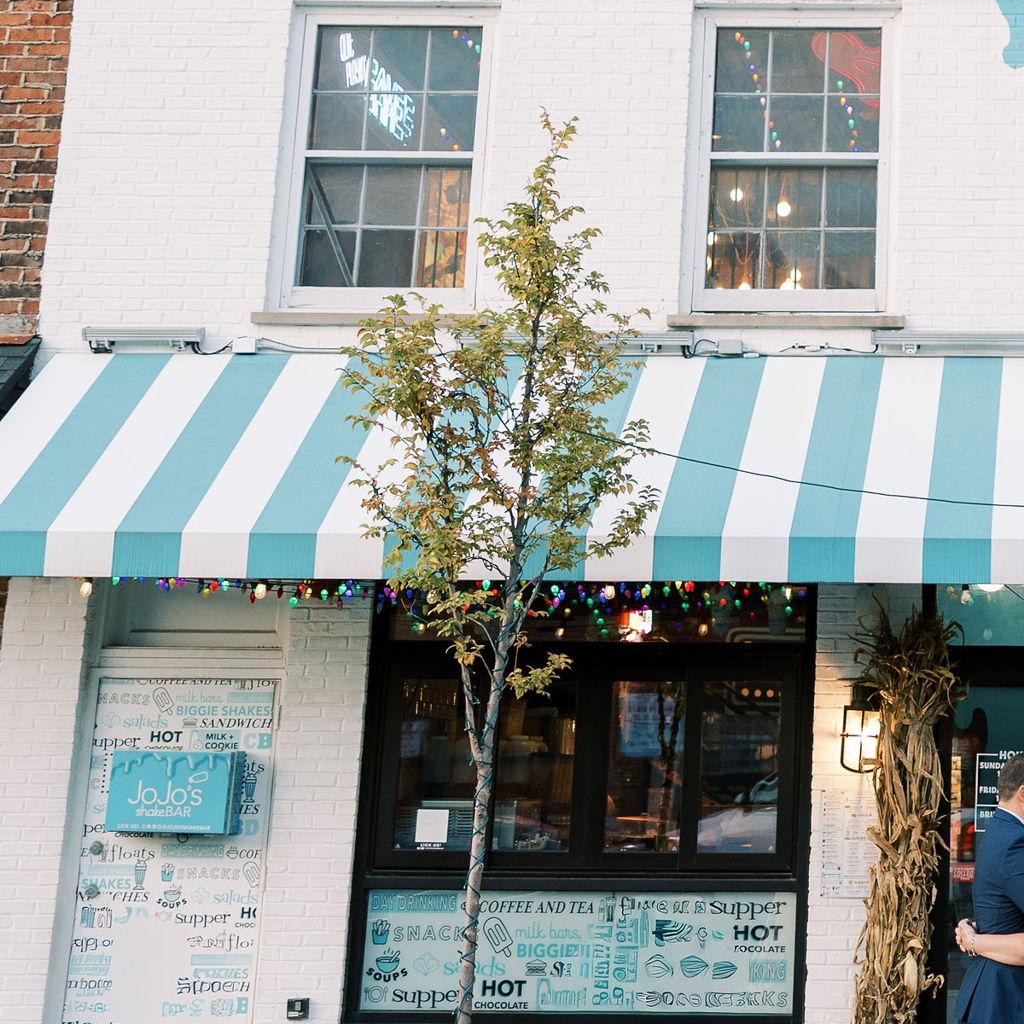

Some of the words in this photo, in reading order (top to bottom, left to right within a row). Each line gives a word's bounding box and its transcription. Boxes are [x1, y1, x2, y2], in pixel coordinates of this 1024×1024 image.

[176, 706, 218, 716] BIGGIE
[222, 706, 270, 716] SHAKES
[200, 718, 272, 729] SANDWICH
[92, 737, 141, 751] upper
[151, 731, 183, 743] HOT
[206, 733, 227, 741] MILK
[205, 742, 239, 751] COOKIE
[979, 786, 999, 794] FRID
[135, 805, 192, 818] shakeBAR
[109, 844, 156, 862] floats
[176, 866, 241, 880] SNACKS
[156, 897, 187, 909] SOUPS
[372, 895, 395, 911] DAY
[400, 895, 457, 912] DRINKING
[480, 900, 533, 914] COFFEE
[535, 901, 566, 914] AND
[569, 901, 594, 914] TEA
[393, 925, 467, 943] SNACK
[515, 922, 545, 939] milk
[733, 925, 783, 941] HOT
[366, 966, 408, 982] SOUPS
[481, 979, 527, 996] HOT
[474, 1001, 528, 1010] CHOCOLATE
